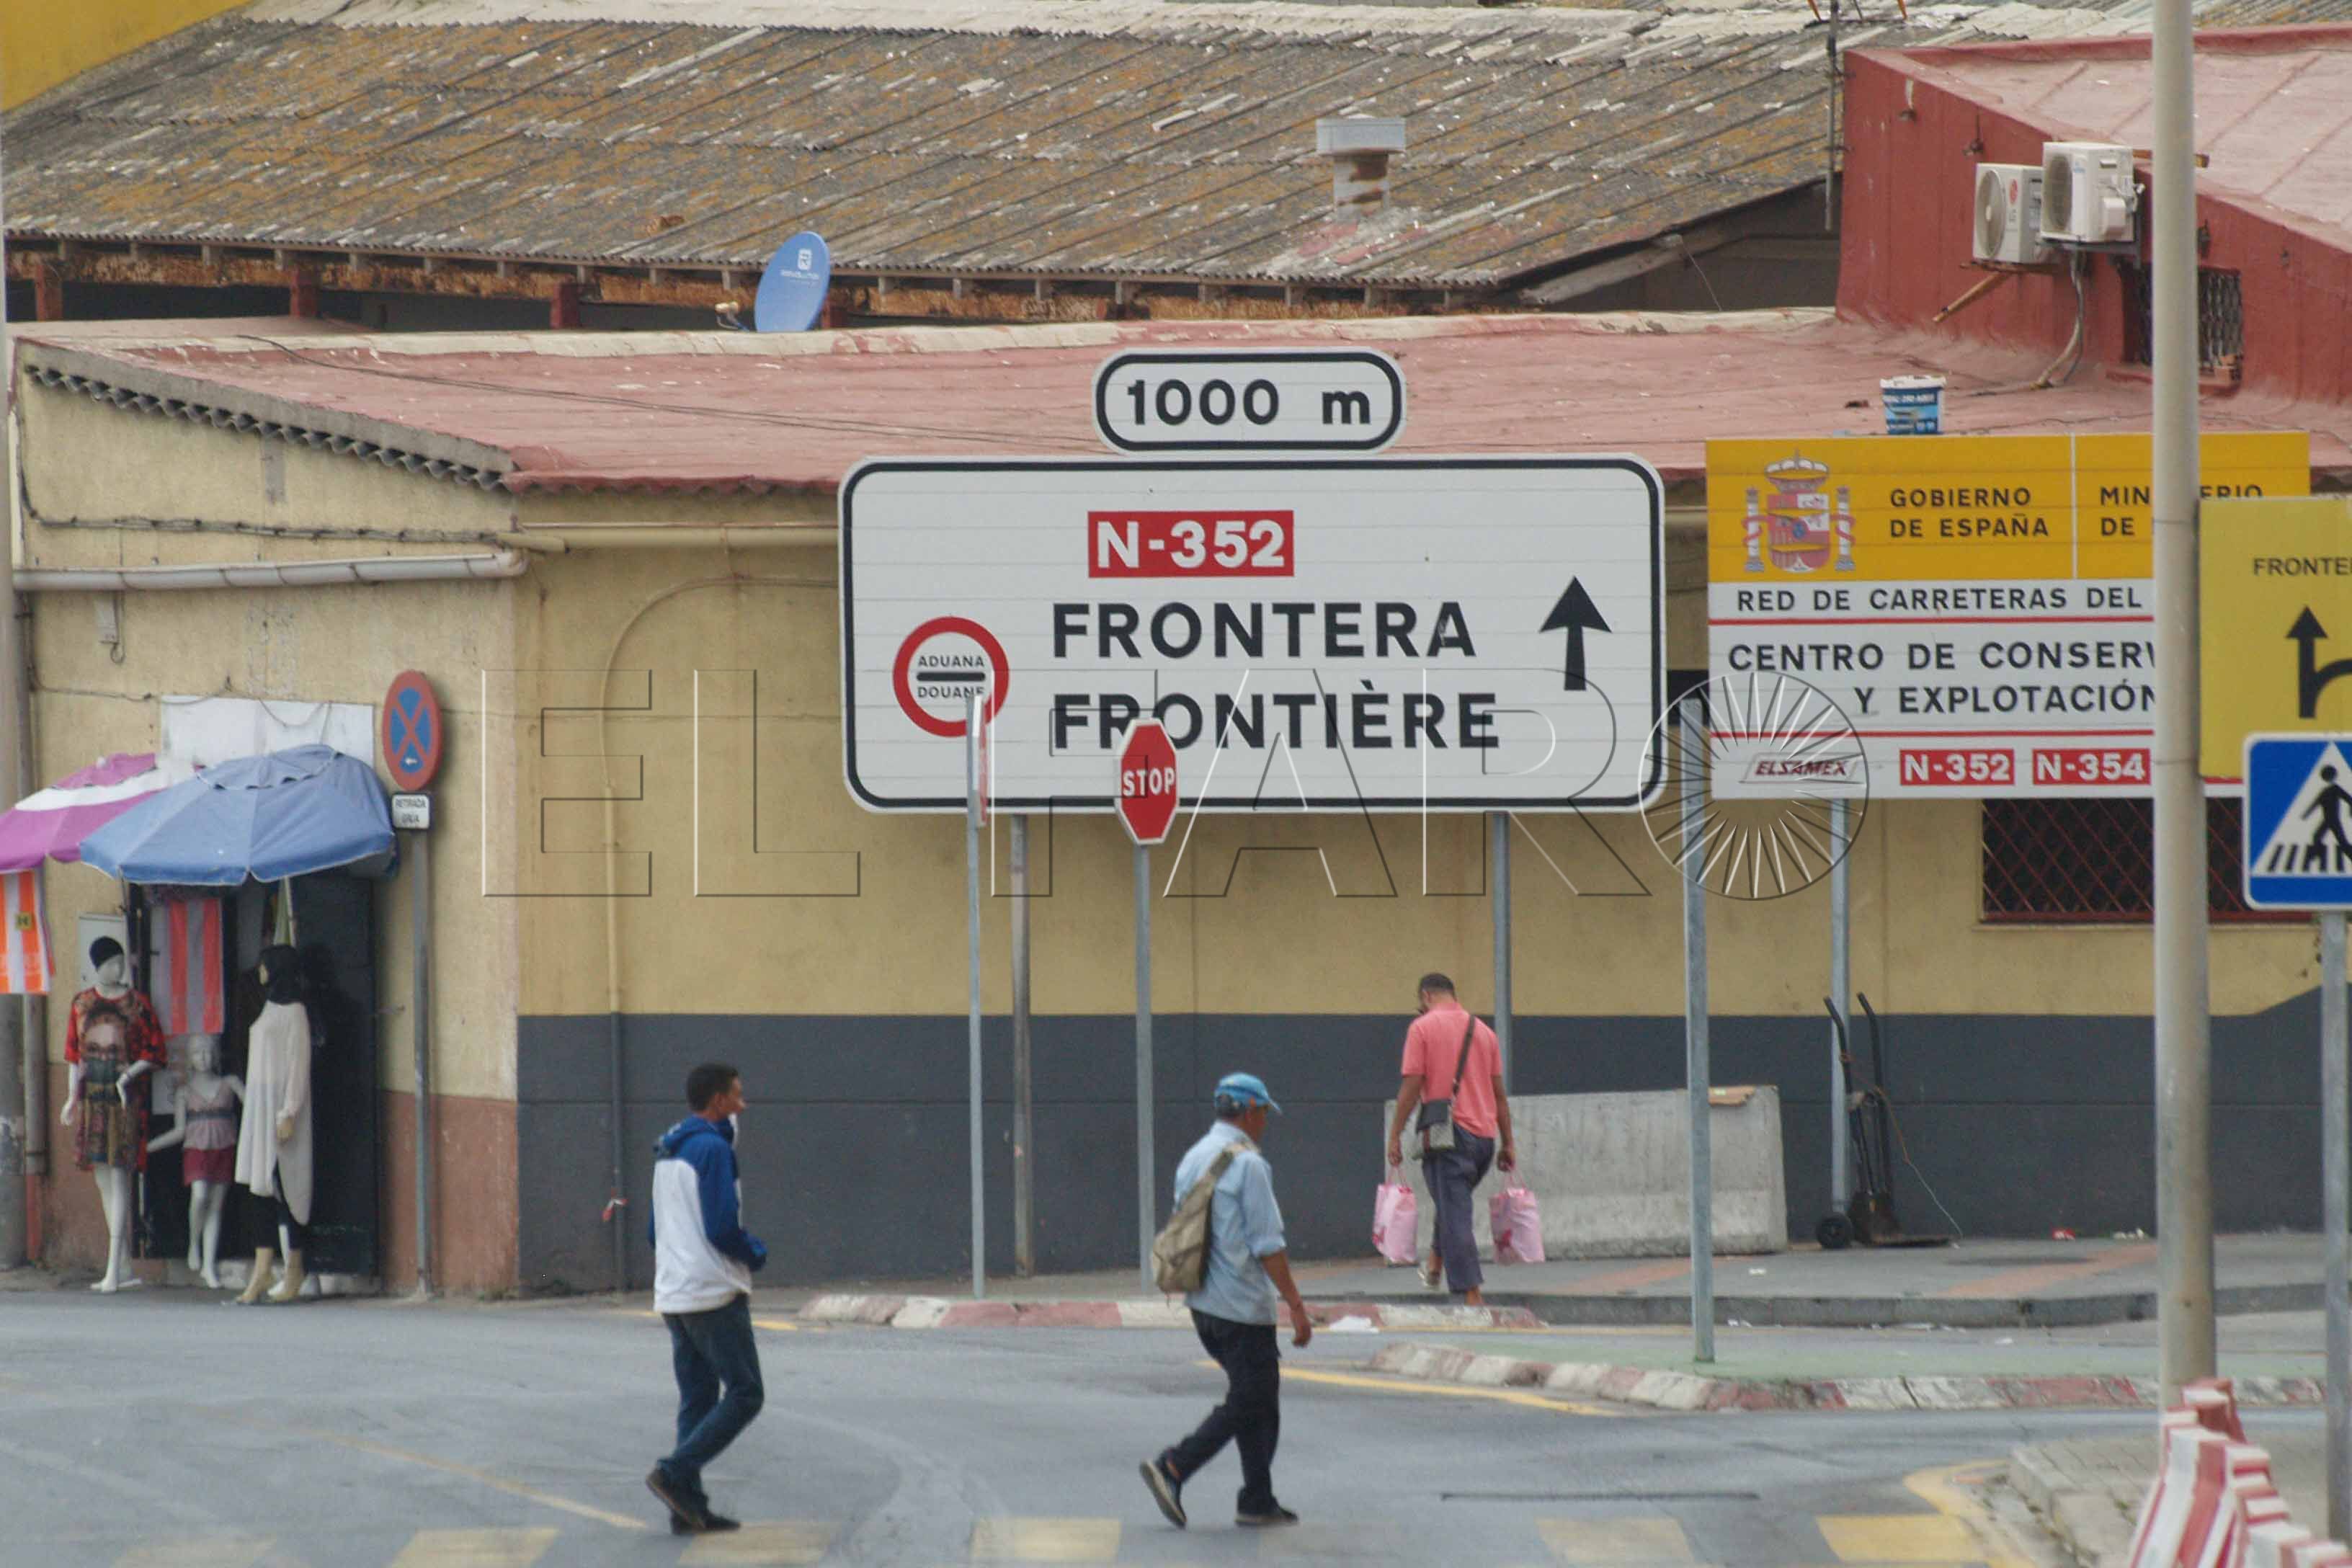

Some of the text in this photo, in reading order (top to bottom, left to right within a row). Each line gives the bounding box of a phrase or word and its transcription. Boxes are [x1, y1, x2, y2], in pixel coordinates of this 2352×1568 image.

[1128, 379, 1370, 425] 1000 m
[1890, 487, 2031, 507] GOBIERNO
[1890, 518, 1923, 538] DE
[1941, 513, 2049, 537] ESPAÑA
[2101, 517, 2136, 536] DE
[1097, 520, 1285, 569] N-352
[2253, 557, 2352, 576] FRONTE
[1738, 587, 2142, 611] RED DE CARRETERAS DEL
[1053, 602, 1476, 658] FRONTERA
[918, 655, 984, 667] ADUANA
[1729, 643, 1884, 671] CENTRO
[1908, 643, 1955, 669] DE
[1854, 687, 1874, 713] Y
[1054, 680, 1500, 749] FRONTIÈRE
[1755, 753, 2146, 781] ELSAMEX N-352 N-354
[1123, 767, 1175, 796] STOP
